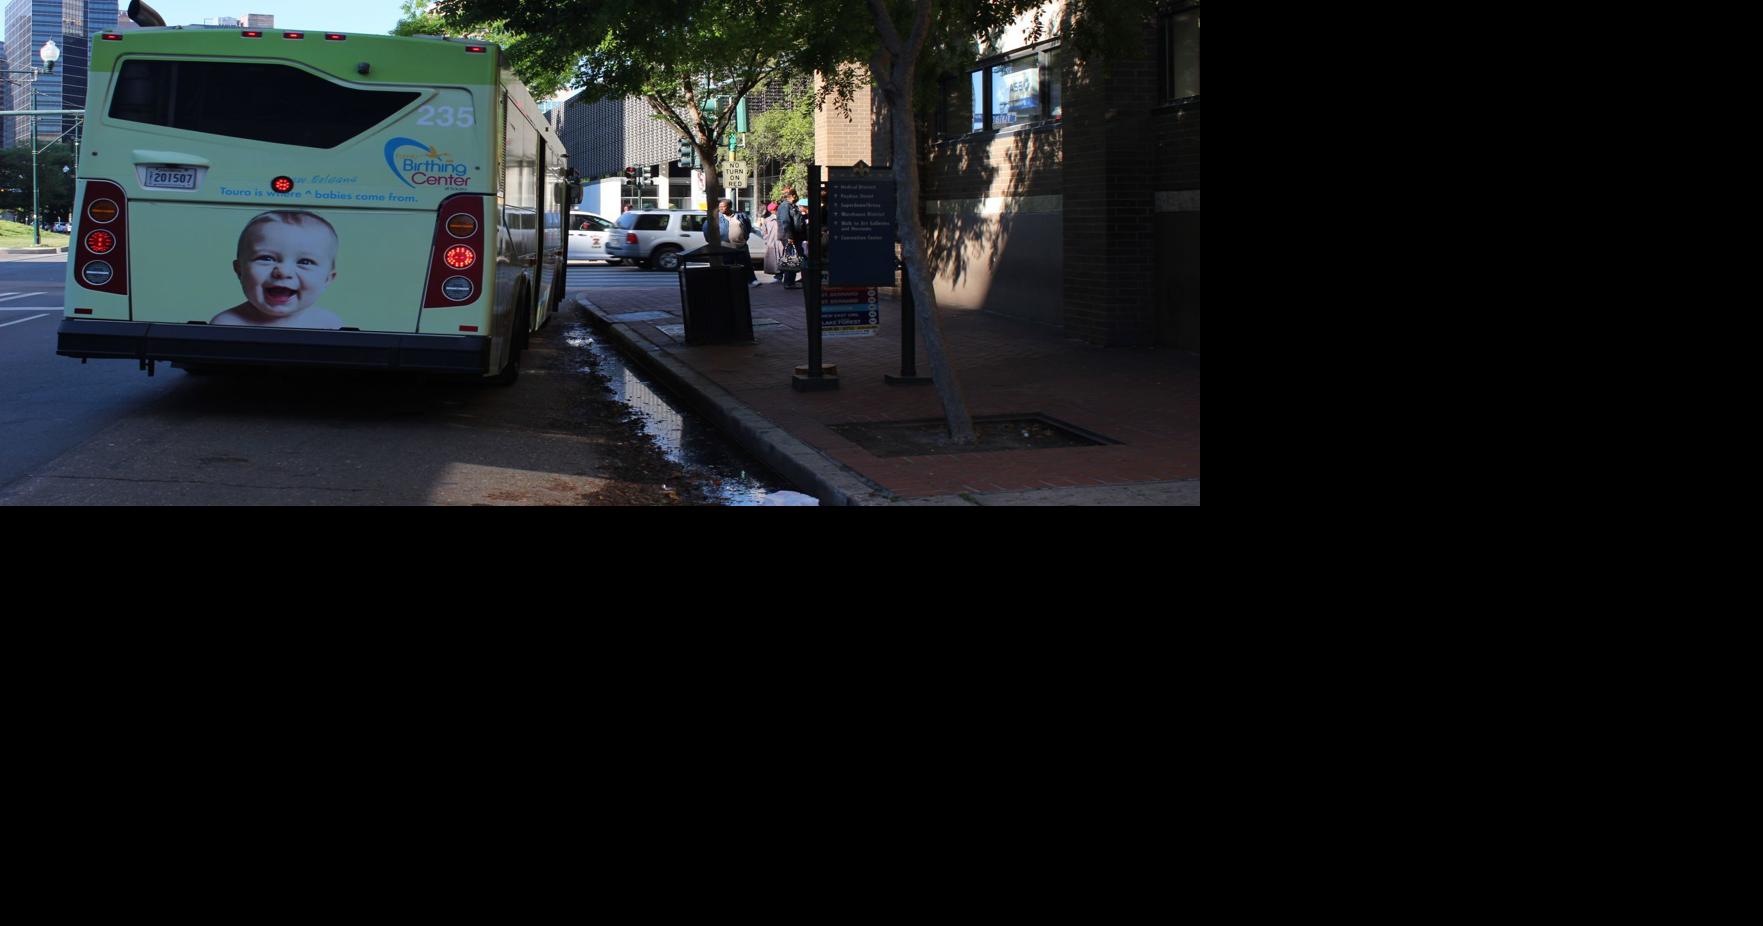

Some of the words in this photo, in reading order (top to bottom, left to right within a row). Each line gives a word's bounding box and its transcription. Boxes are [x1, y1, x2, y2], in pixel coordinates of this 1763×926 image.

[416, 105, 474, 127] 235
[403, 158, 467, 176] Birthing
[154, 172, 193, 184] 201507
[411, 171, 471, 186] Center
[220, 187, 251, 196] Touro
[255, 188, 263, 197] is
[315, 190, 353, 200] babies
[355, 193, 385, 201] come
[388, 193, 418, 202] from.
